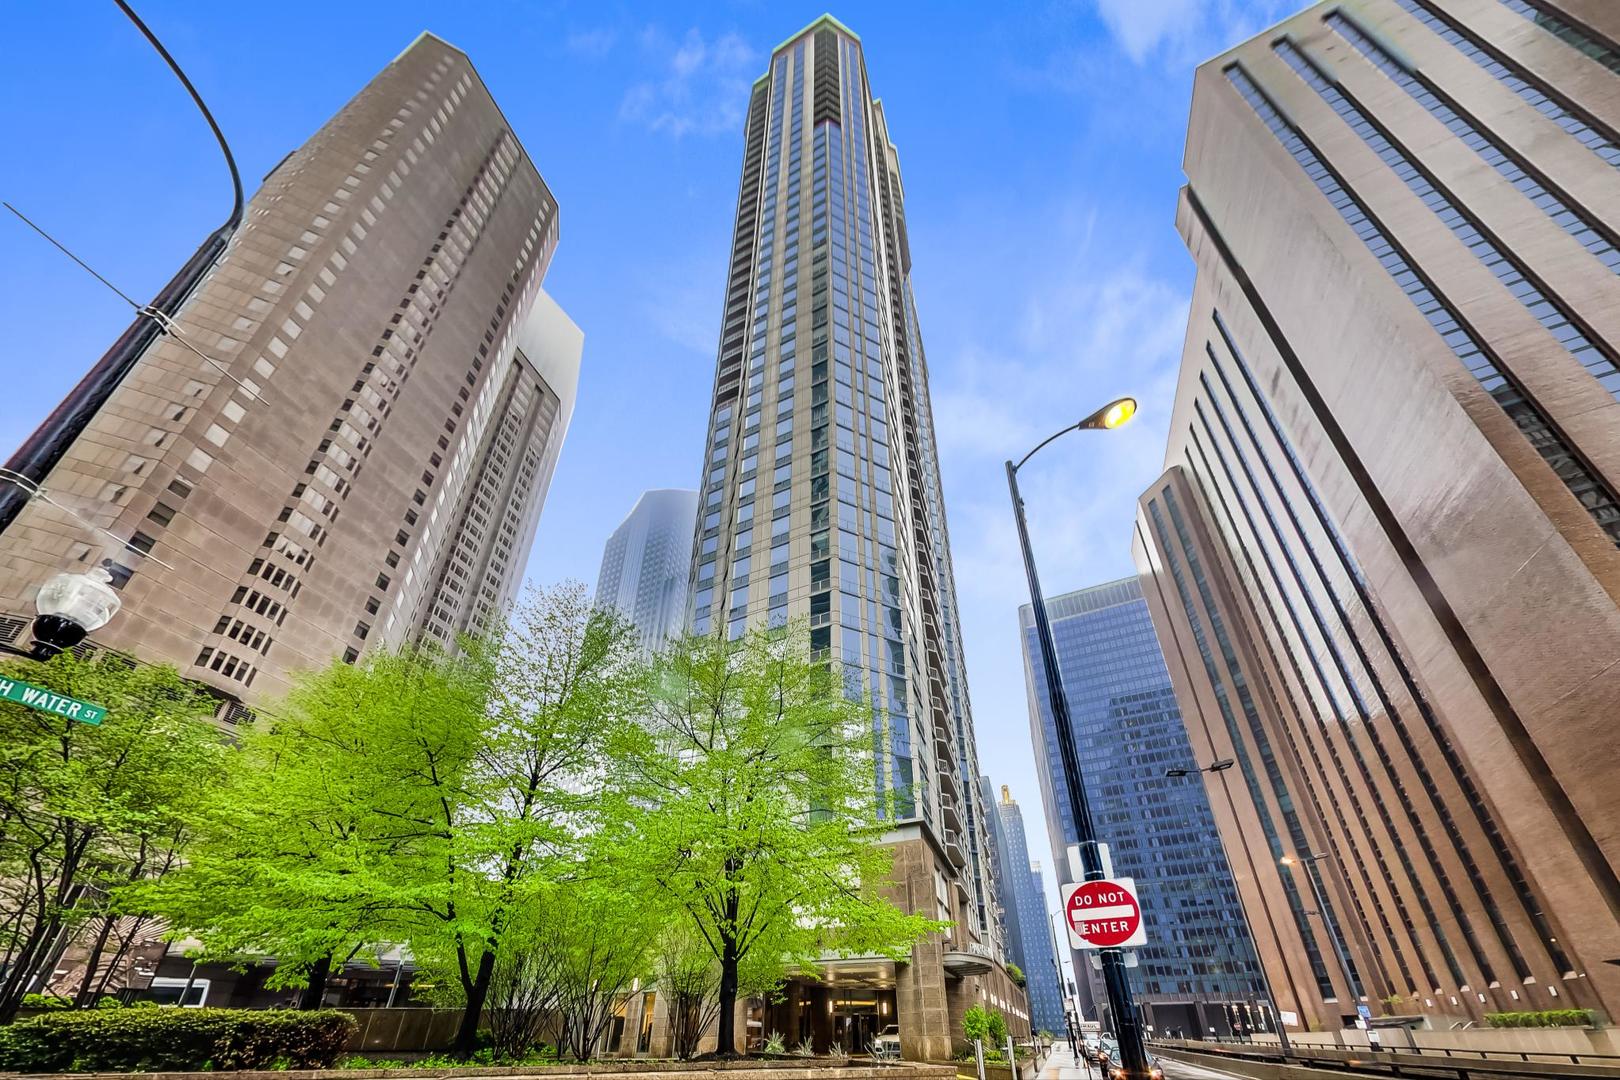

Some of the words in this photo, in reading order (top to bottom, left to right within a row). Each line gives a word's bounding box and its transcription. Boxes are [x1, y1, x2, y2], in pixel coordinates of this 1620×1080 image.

[0, 679, 15, 697] H
[22, 687, 82, 718] WATER
[84, 709, 98, 719] ST
[1075, 895, 1092, 906] DO
[1098, 891, 1125, 904] NOT
[1082, 921, 1129, 935] ENTER
